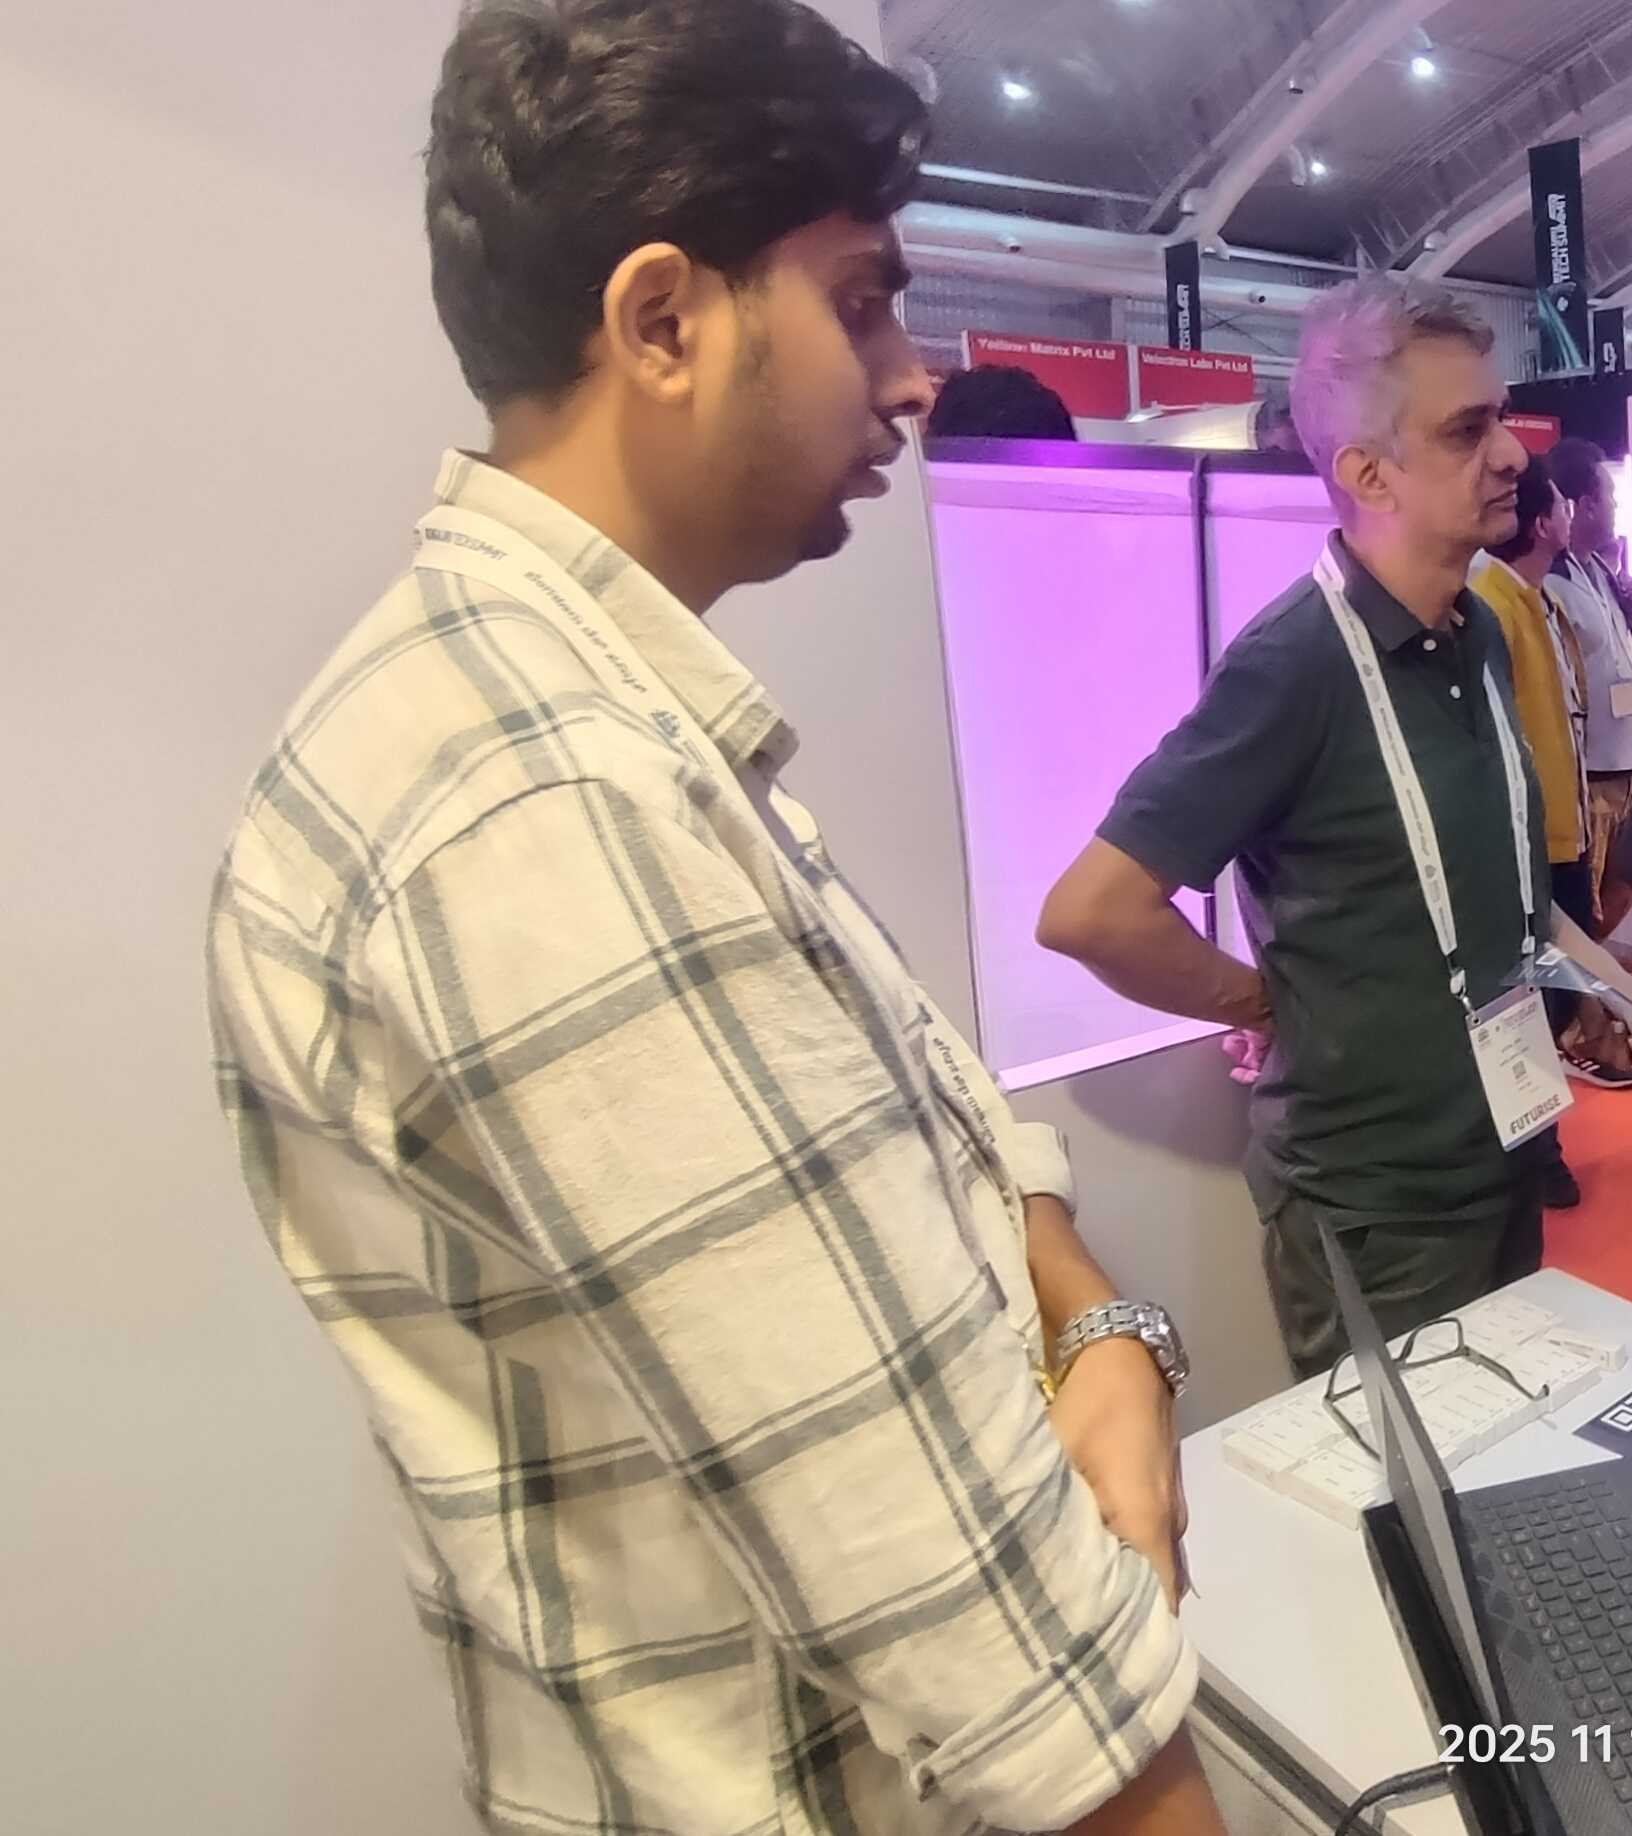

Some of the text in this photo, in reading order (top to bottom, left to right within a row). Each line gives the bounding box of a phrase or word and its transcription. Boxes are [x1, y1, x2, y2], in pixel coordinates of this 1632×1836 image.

[1095, 348, 1116, 360] Ltd
[1215, 359, 1231, 371] Pvt
[1232, 361, 1248, 373] Ltd
[1509, 1093, 1561, 1134] FUTURISE
